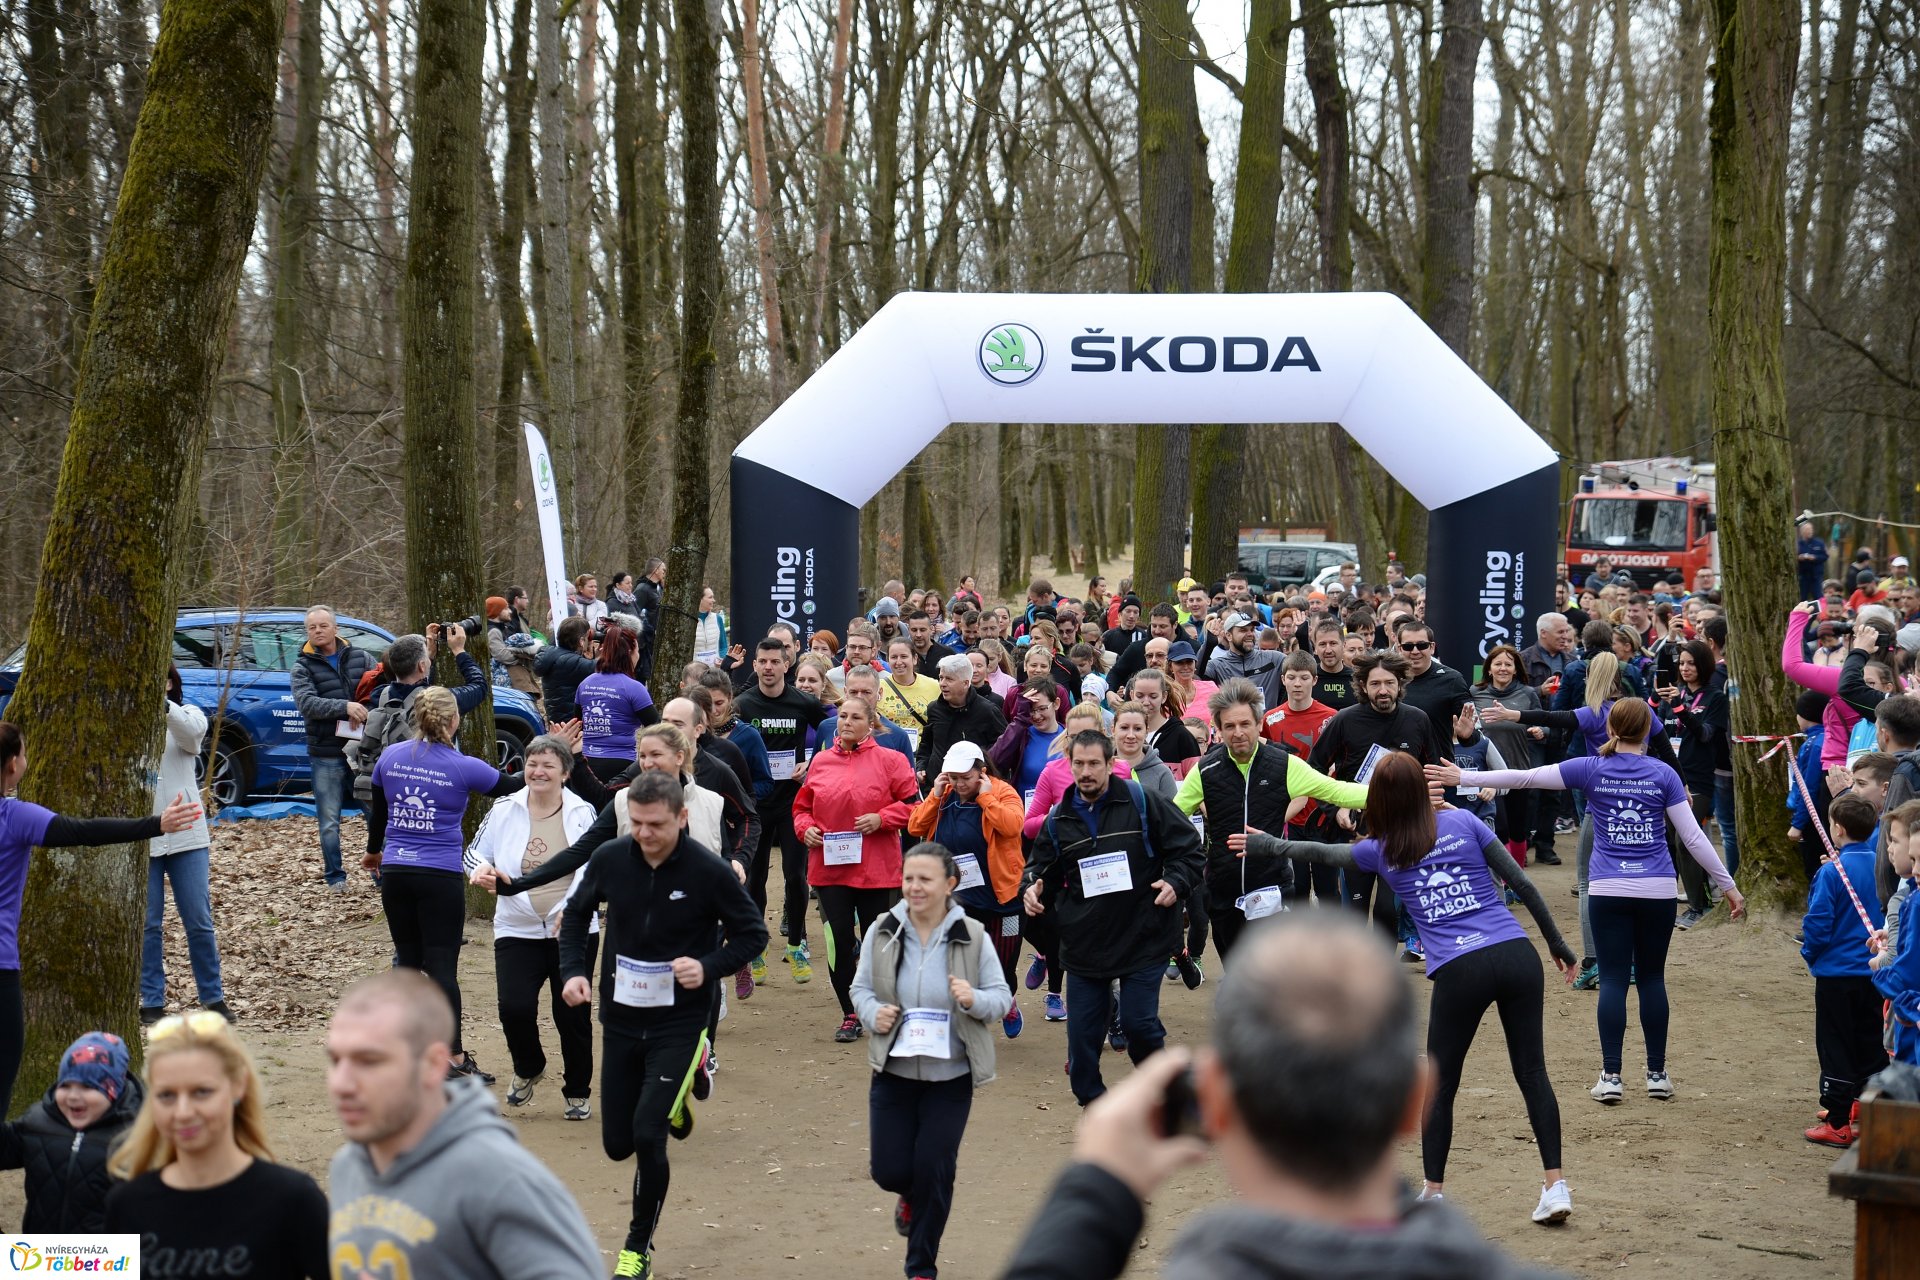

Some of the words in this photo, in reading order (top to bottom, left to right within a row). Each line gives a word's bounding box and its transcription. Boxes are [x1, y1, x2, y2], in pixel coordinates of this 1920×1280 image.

[1071, 328, 1322, 372] ŠKODA
[804, 548, 814, 597] ŠKODA
[1513, 552, 1524, 600] ŠKODA
[771, 547, 801, 634] ycling
[1479, 551, 1512, 660] Cycling
[1513, 630, 1523, 652] ereje
[762, 718, 796, 728] SPARTAN
[1607, 820, 1654, 832] BÁTOR
[1434, 833, 1455, 846] rtem.
[1442, 839, 1468, 852] vagyok.
[1096, 871, 1109, 880] 144
[1419, 880, 1473, 908] BÁTOR
[1424, 893, 1478, 921] TÁBOR
[632, 980, 648, 990] 244
[909, 1028, 925, 1037] 292
